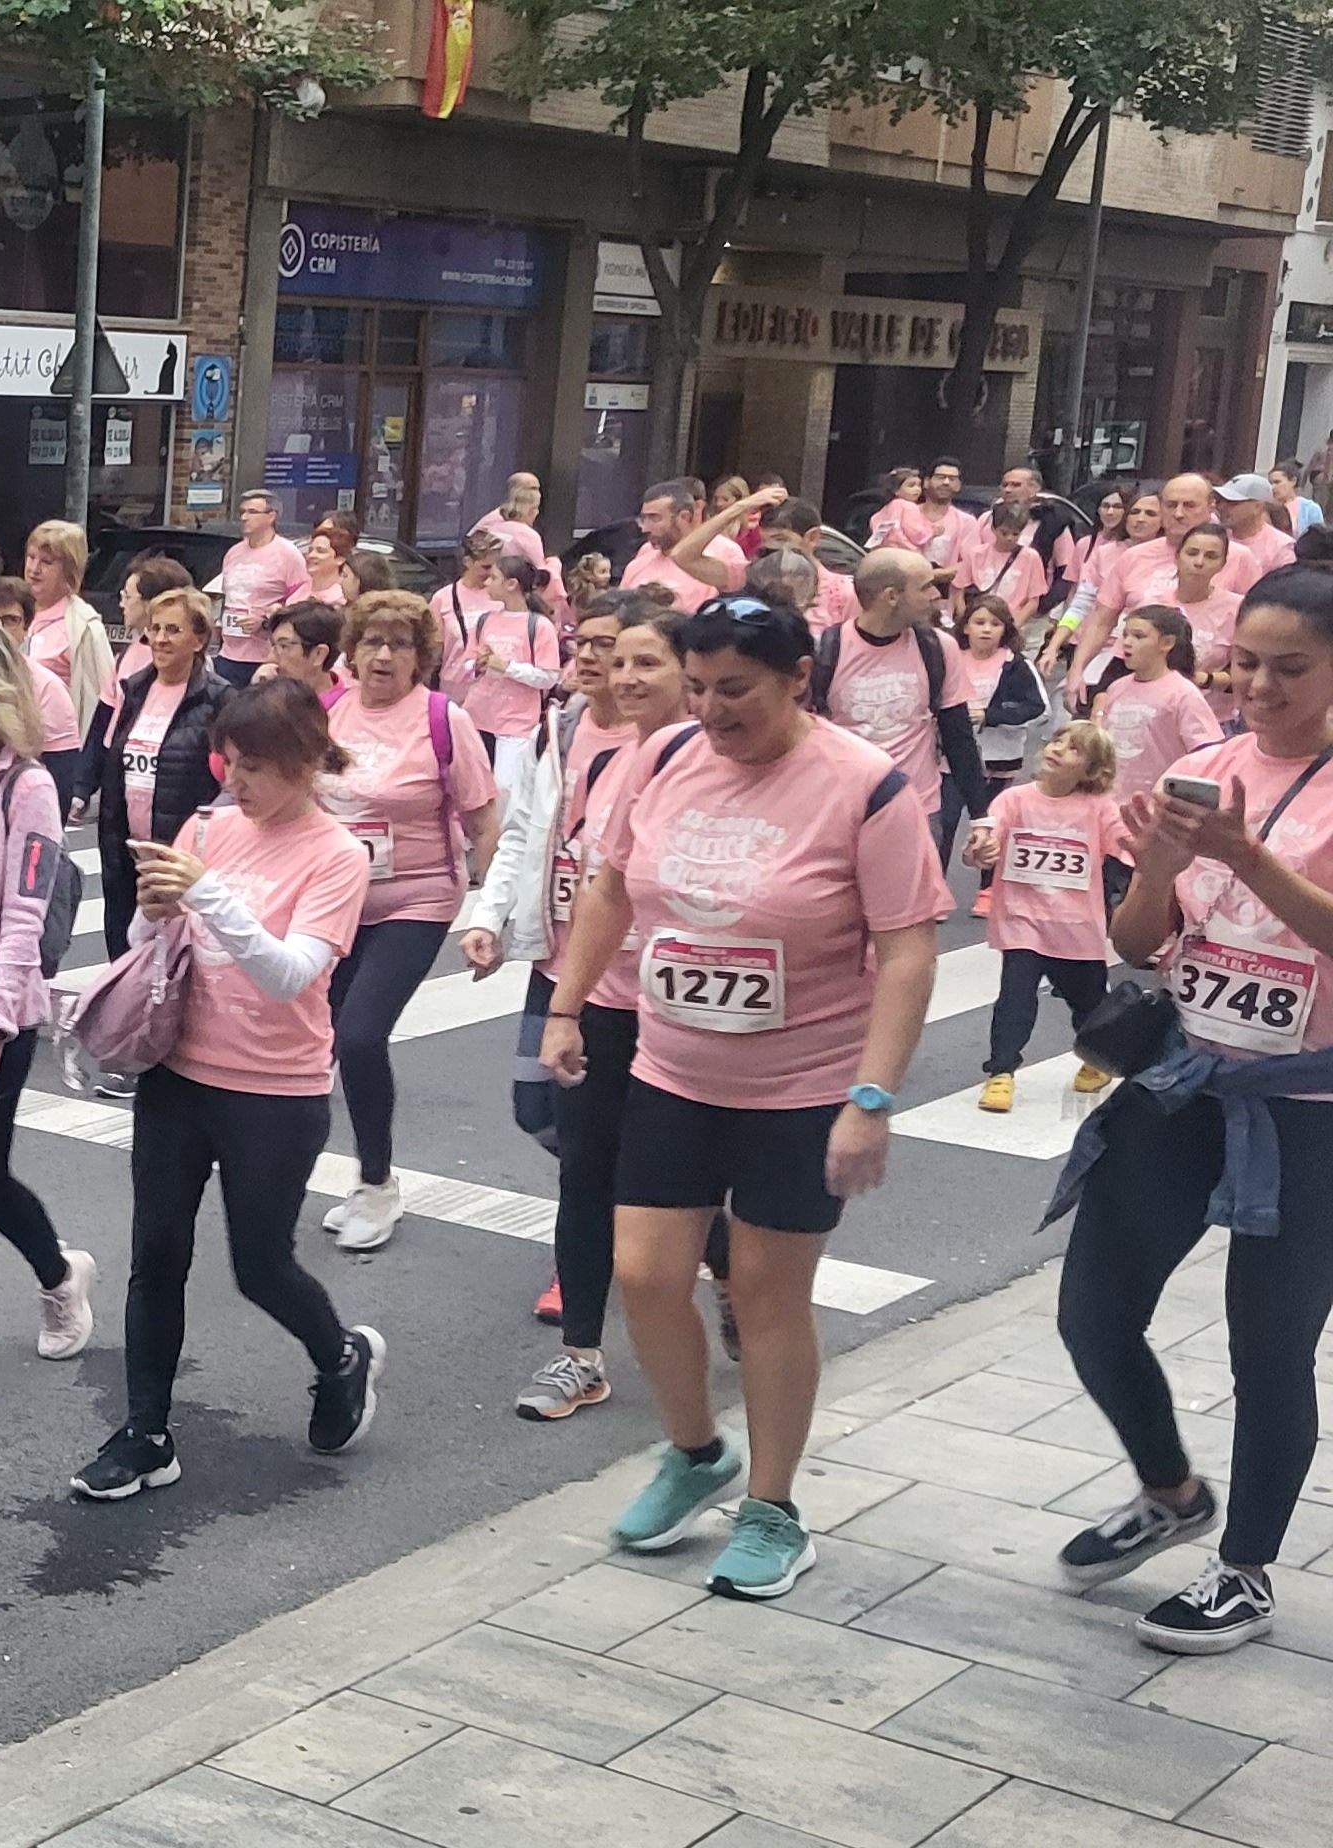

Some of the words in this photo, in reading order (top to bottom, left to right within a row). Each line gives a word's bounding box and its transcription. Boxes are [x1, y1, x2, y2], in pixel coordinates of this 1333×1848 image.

[309, 256, 336, 274] CRM
[122, 753, 159, 775] 209
[1013, 847, 1086, 875] 3733
[655, 966, 772, 1010] 1272
[1178, 964, 1299, 1028] 3748
